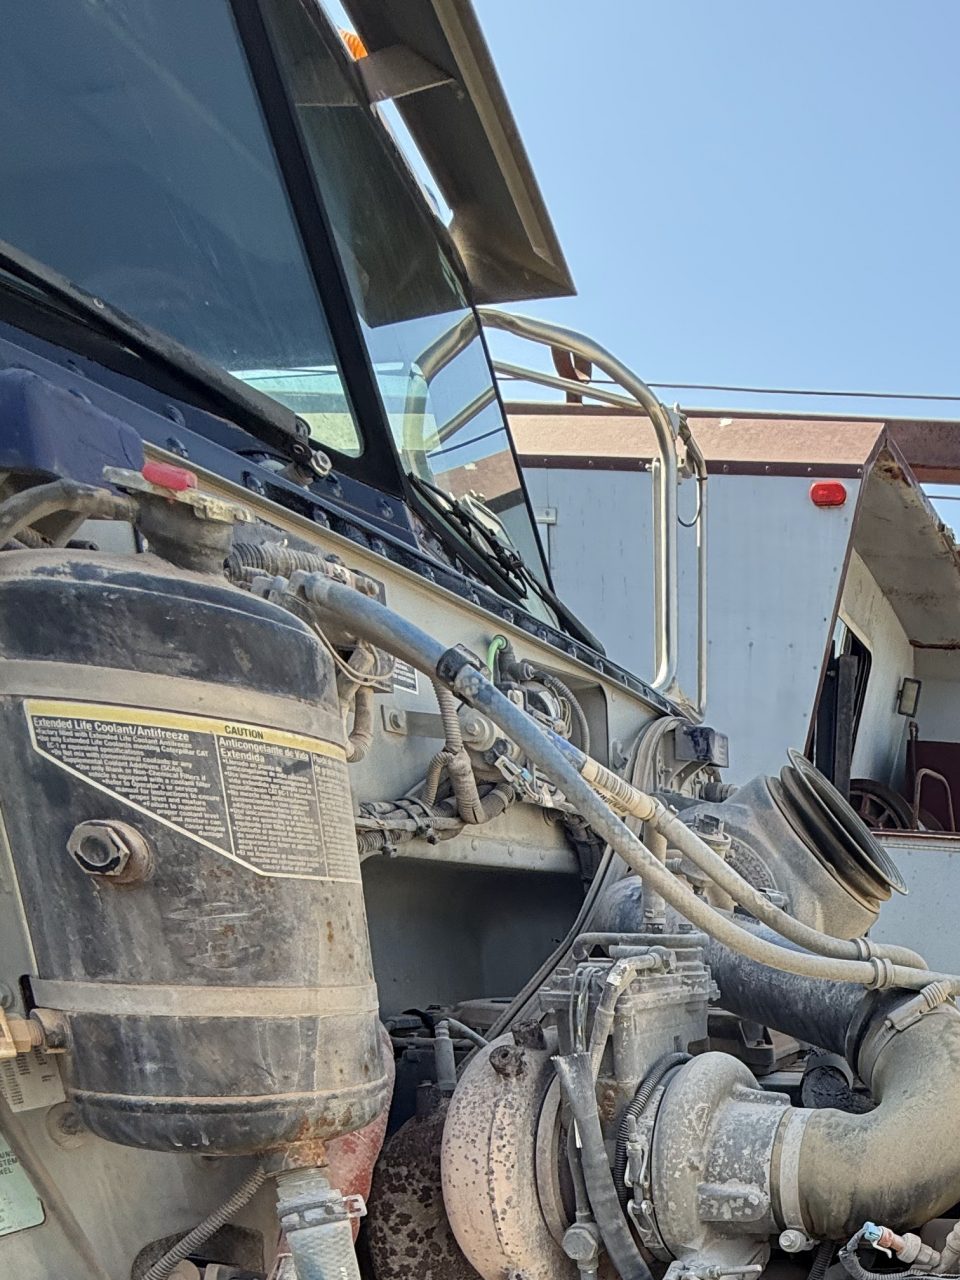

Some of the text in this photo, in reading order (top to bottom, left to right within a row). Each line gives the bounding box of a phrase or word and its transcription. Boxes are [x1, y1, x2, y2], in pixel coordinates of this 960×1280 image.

[33, 717, 189, 741] Extended Life Coolant/Antifreeze
[224, 725, 264, 740] CAUTION
[221, 748, 265, 763] Extendida
